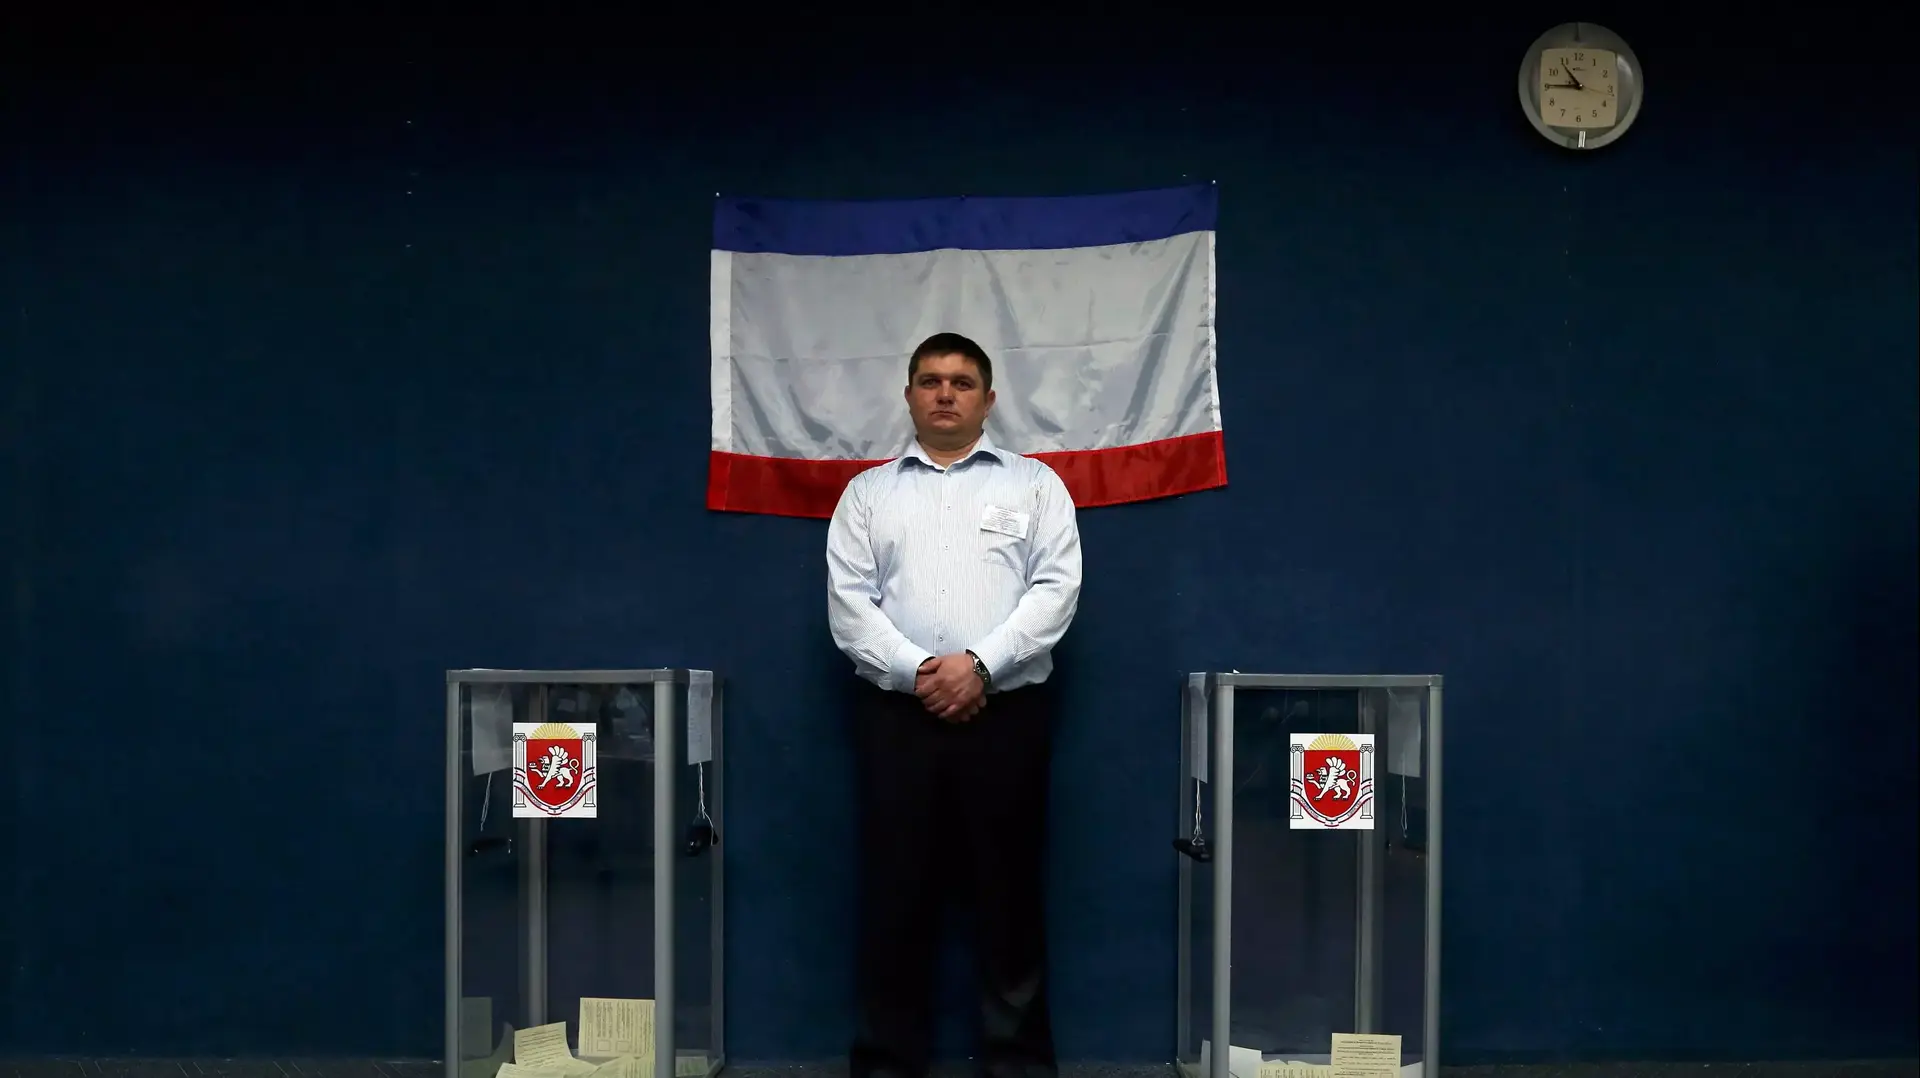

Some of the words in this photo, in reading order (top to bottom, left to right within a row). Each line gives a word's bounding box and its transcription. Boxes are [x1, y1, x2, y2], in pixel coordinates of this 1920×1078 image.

[1574, 53, 1584, 61] 12
[1592, 58, 1596, 66] 1
[1549, 68, 1558, 76] 10
[1602, 70, 1608, 78] 2
[1607, 85, 1613, 93] 3
[1549, 98, 1555, 106] 8
[1560, 108, 1566, 117] 7
[1592, 109, 1597, 118] 5
